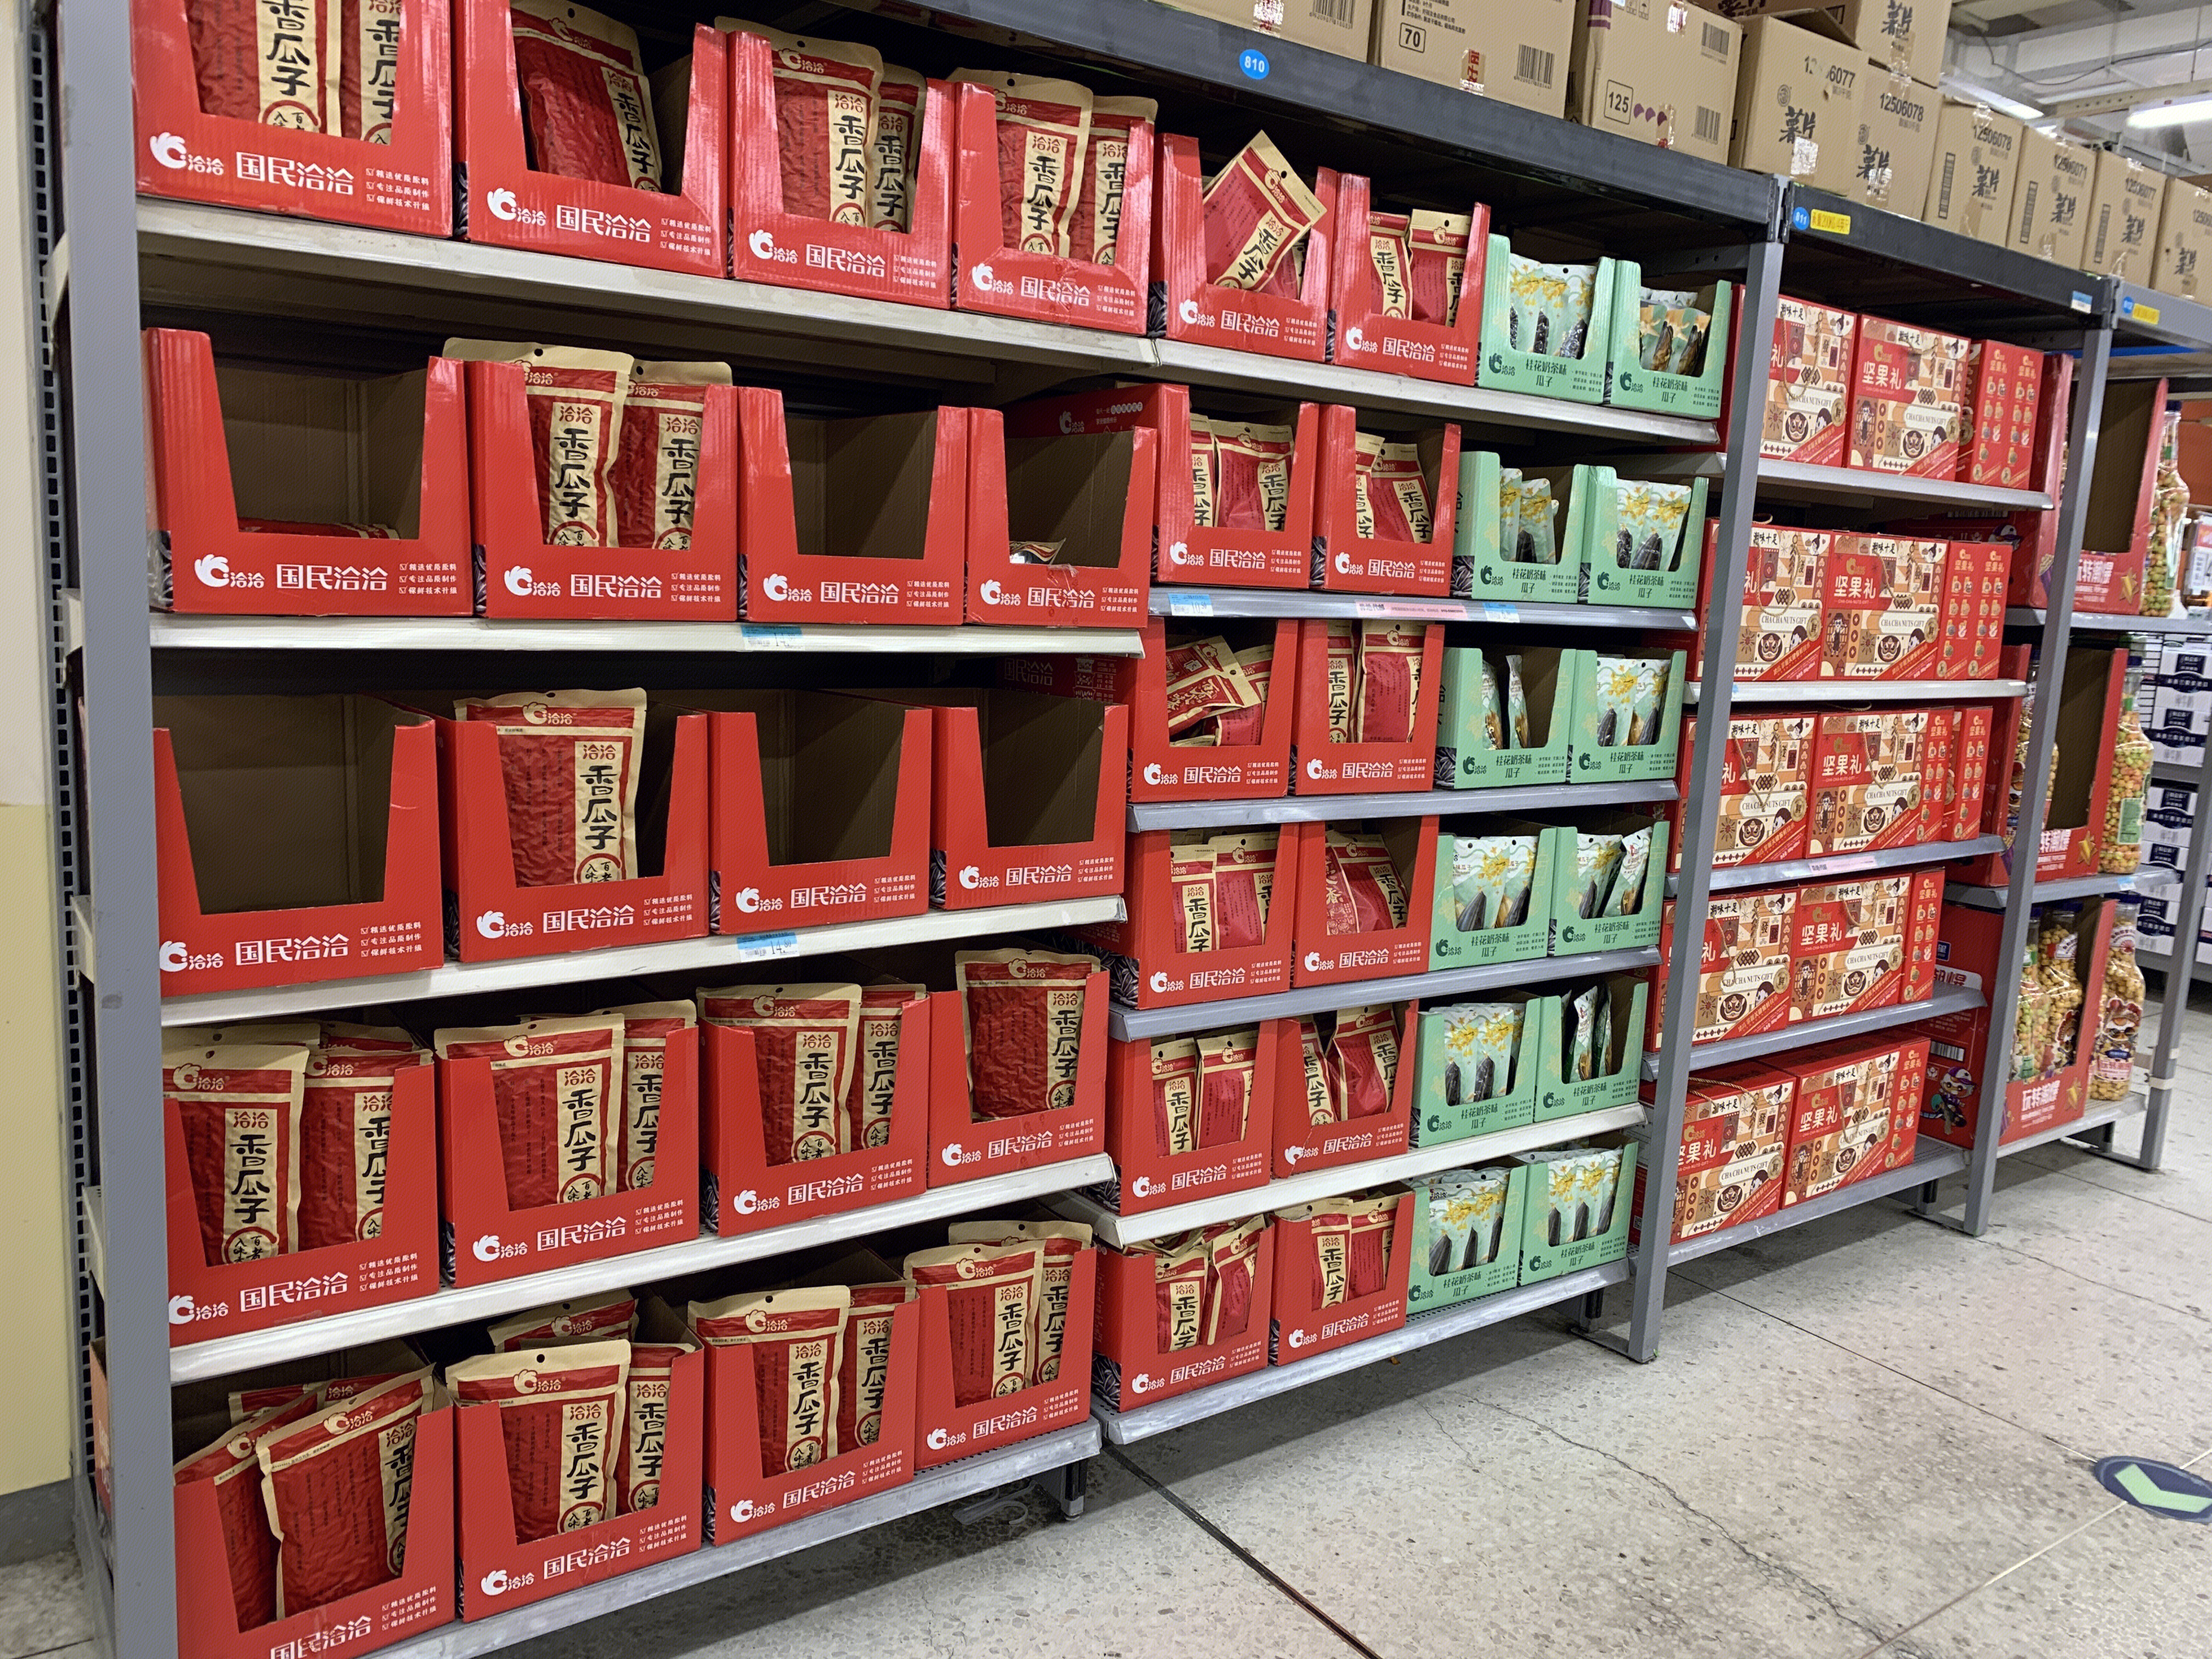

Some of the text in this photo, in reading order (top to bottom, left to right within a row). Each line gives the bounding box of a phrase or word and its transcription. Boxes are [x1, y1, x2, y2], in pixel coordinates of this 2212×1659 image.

[1404, 28, 1421, 47] 70
[1244, 55, 1265, 72] 810
[1608, 90, 1629, 113] 125
[1880, 93, 1924, 121] 12506078
[188, 154, 224, 176] 洽洽
[236, 151, 354, 195] 国民洽洽
[517, 208, 546, 226] 洽洽
[556, 205, 651, 242] 国民洽洽
[1795, 212, 1807, 225] 811
[774, 247, 798, 263] 洽洽
[806, 244, 885, 277] 国民洽洽
[992, 279, 1014, 295] 洽洽
[1221, 311, 1280, 337] 国民洽洽
[1383, 337, 1436, 362] 国民洽洽
[1526, 359, 1567, 375] 桂花奶茶味
[1862, 361, 1901, 390] 坚果礼
[1536, 375, 1553, 386] 瓜子
[1652, 376, 1688, 392] 桂花奶茶味
[1662, 392, 1675, 403] 瓜子
[1187, 554, 1204, 566] 洽洽
[1210, 549, 1266, 569] 国民洽洽
[1368, 559, 1415, 578] 国民洽洽
[1513, 568, 1547, 581] 桂花奶茶味
[230, 571, 264, 588] 洽洽
[276, 564, 388, 591] 国民洽洽
[571, 574, 662, 597] 国民洽洽
[1629, 574, 1664, 586] 桂花奶茶味
[533, 582, 561, 597] 洽洽
[787, 588, 812, 602] 洽洽
[821, 582, 899, 604] 国民洽洽
[1522, 582, 1535, 593] 瓜子
[1638, 588, 1652, 599] 瓜子
[1834, 575, 1876, 599] 坚果礼
[1028, 588, 1094, 608] 国民洽洽
[1496, 754, 1532, 766] 桂花奶茶味
[1610, 751, 1644, 762] 桂花奶茶味
[1342, 762, 1393, 778] 国民洽洽
[1505, 768, 1520, 778] 瓜子
[1619, 764, 1633, 774] 瓜子
[1821, 755, 1862, 777] 坚果礼
[1184, 766, 1242, 784] 国民洽洽
[979, 876, 999, 888] 洽洽
[1006, 864, 1073, 887] 国民洽洽
[759, 898, 783, 911] 洽洽
[791, 883, 867, 909] 国民洽洽
[543, 905, 635, 933] 国民洽洽
[1595, 921, 1629, 933] 桂花奶茶味
[505, 922, 533, 936] 洽洽
[1801, 923, 1842, 945] 坚果礼
[1471, 933, 1509, 947] 桂花奶茶味
[1604, 934, 1617, 944] 瓜子
[235, 933, 349, 966] 国民洽洽
[1339, 948, 1390, 968] 国民洽洽
[1482, 946, 1497, 957] 瓜子
[189, 952, 224, 970] 洽洽
[1189, 967, 1245, 989] 国民洽洽
[1573, 1081, 1607, 1097] 桂花奶茶味
[1582, 1096, 1596, 1106] 瓜子
[1461, 1103, 1498, 1119] 桂花奶茶味
[1799, 1105, 1838, 1131] 坚果礼
[1472, 1118, 1486, 1128] 瓜子
[1323, 1133, 1373, 1154] 国民洽洽
[961, 1150, 981, 1164] 洽洽
[1172, 1164, 1227, 1190] 国民洽洽
[788, 1173, 864, 1206] 国民洽洽
[757, 1197, 780, 1211] 洽洽
[537, 1217, 627, 1251] 国民洽洽
[500, 1242, 528, 1259] 洽洽
[1561, 1242, 1595, 1258] 桂花奶茶味
[1570, 1255, 1583, 1266] 瓜子
[1444, 1271, 1481, 1288] 桂花奶茶味
[240, 1272, 348, 1312] 国民洽洽
[1453, 1285, 1468, 1296] 瓜子
[196, 1302, 229, 1319] 洽洽
[1322, 1313, 1369, 1340] 国民洽洽
[1170, 1355, 1226, 1385] 国民洽洽
[973, 1407, 1037, 1440] 国民洽洽
[947, 1431, 966, 1447] 洽洽
[783, 1471, 855, 1508] 国民洽洽
[753, 1503, 775, 1519] 洽洽
[544, 1537, 630, 1579] 国民洽洽
[508, 1572, 534, 1589] 洽洽
